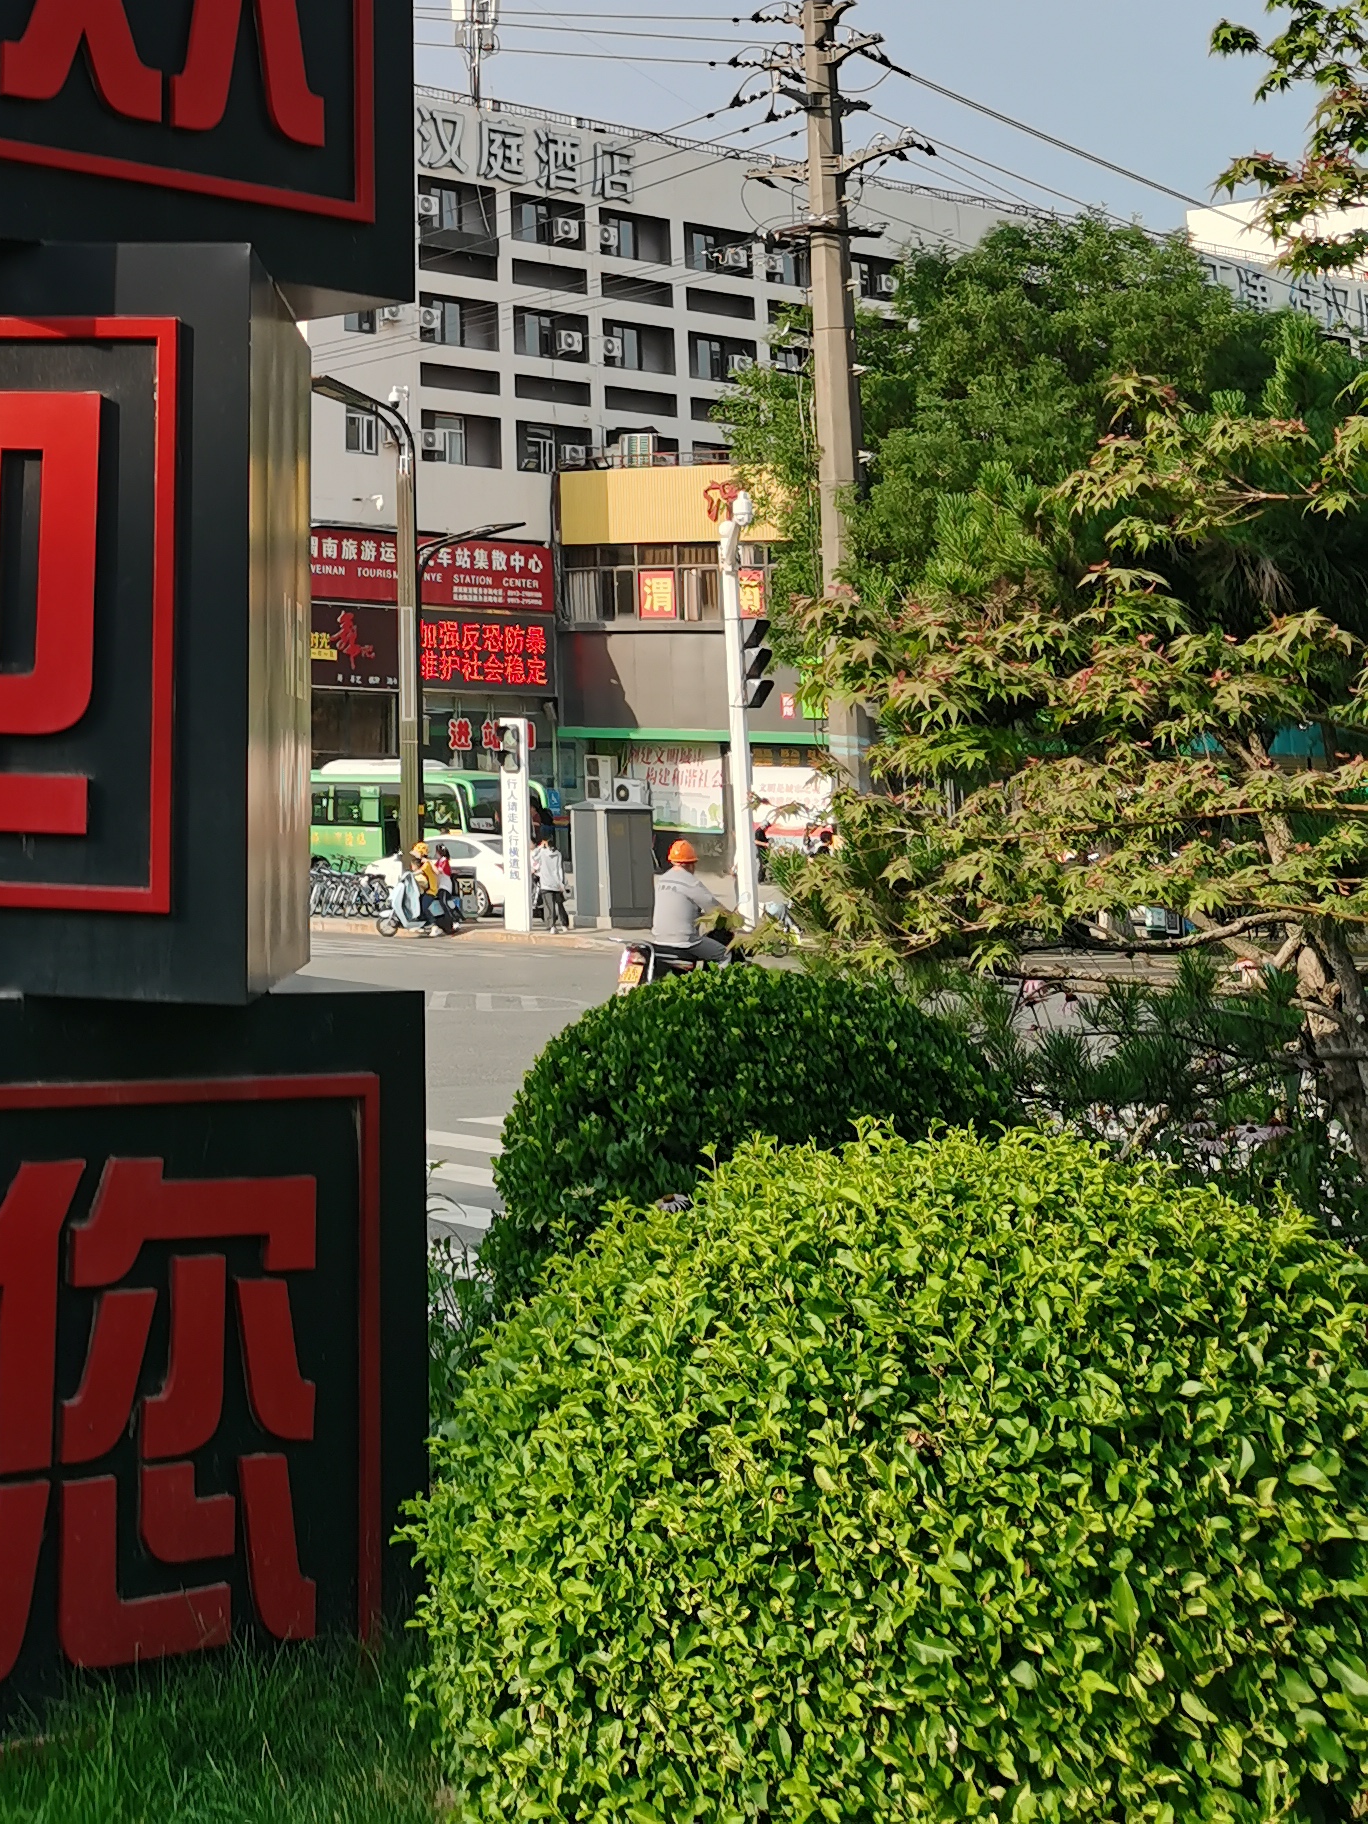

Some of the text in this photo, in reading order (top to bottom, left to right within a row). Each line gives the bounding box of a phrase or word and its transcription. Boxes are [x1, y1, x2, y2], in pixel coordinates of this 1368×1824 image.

[417, 105, 635, 204] 汉庭酒店
[453, 573, 492, 585] STATION
[503, 577, 539, 589] CENTER
[644, 577, 672, 612] 渭
[420, 619, 547, 654] 加强反恐防暴
[507, 778, 521, 881] 行人请走人行横道线
